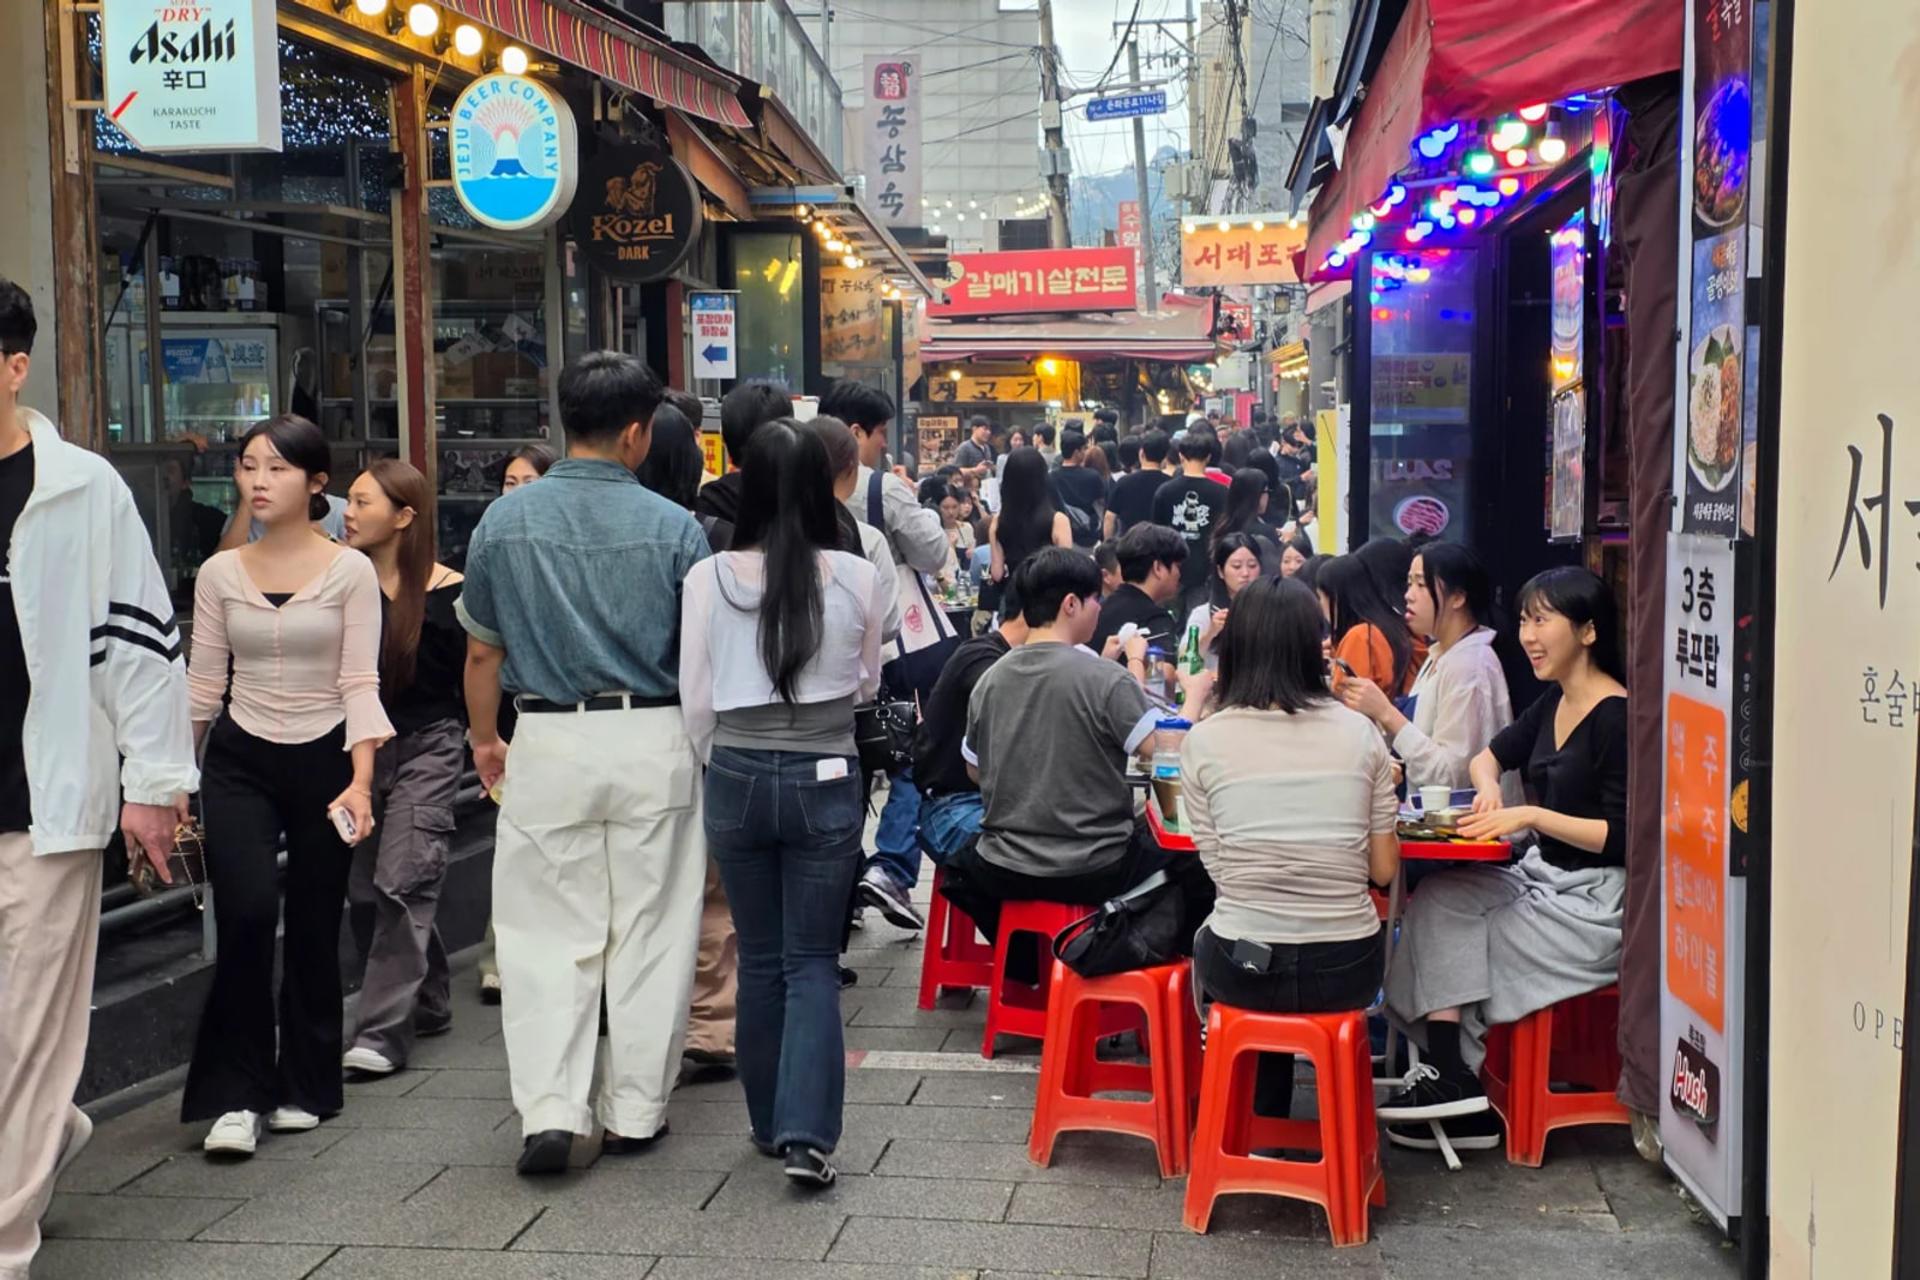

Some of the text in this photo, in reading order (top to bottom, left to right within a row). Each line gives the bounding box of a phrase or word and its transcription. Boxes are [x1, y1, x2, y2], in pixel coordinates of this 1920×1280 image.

[129, 18, 236, 64] Asahi
[163, 69, 206, 90] 辛口
[153, 107, 216, 117] KARAKUCHI
[170, 120, 201, 130] TASTE
[457, 80, 559, 174] JEJU BEER COMPANY
[876, 104, 907, 218] 종삼육
[591, 213, 674, 242] Kozel
[618, 245, 649, 260] DARK
[966, 266, 1128, 299] 갈매기살전문
[1681, 566, 1716, 622] 3층
[1676, 627, 1720, 688] 루프탑
[1673, 1050, 1708, 1119] Hush
